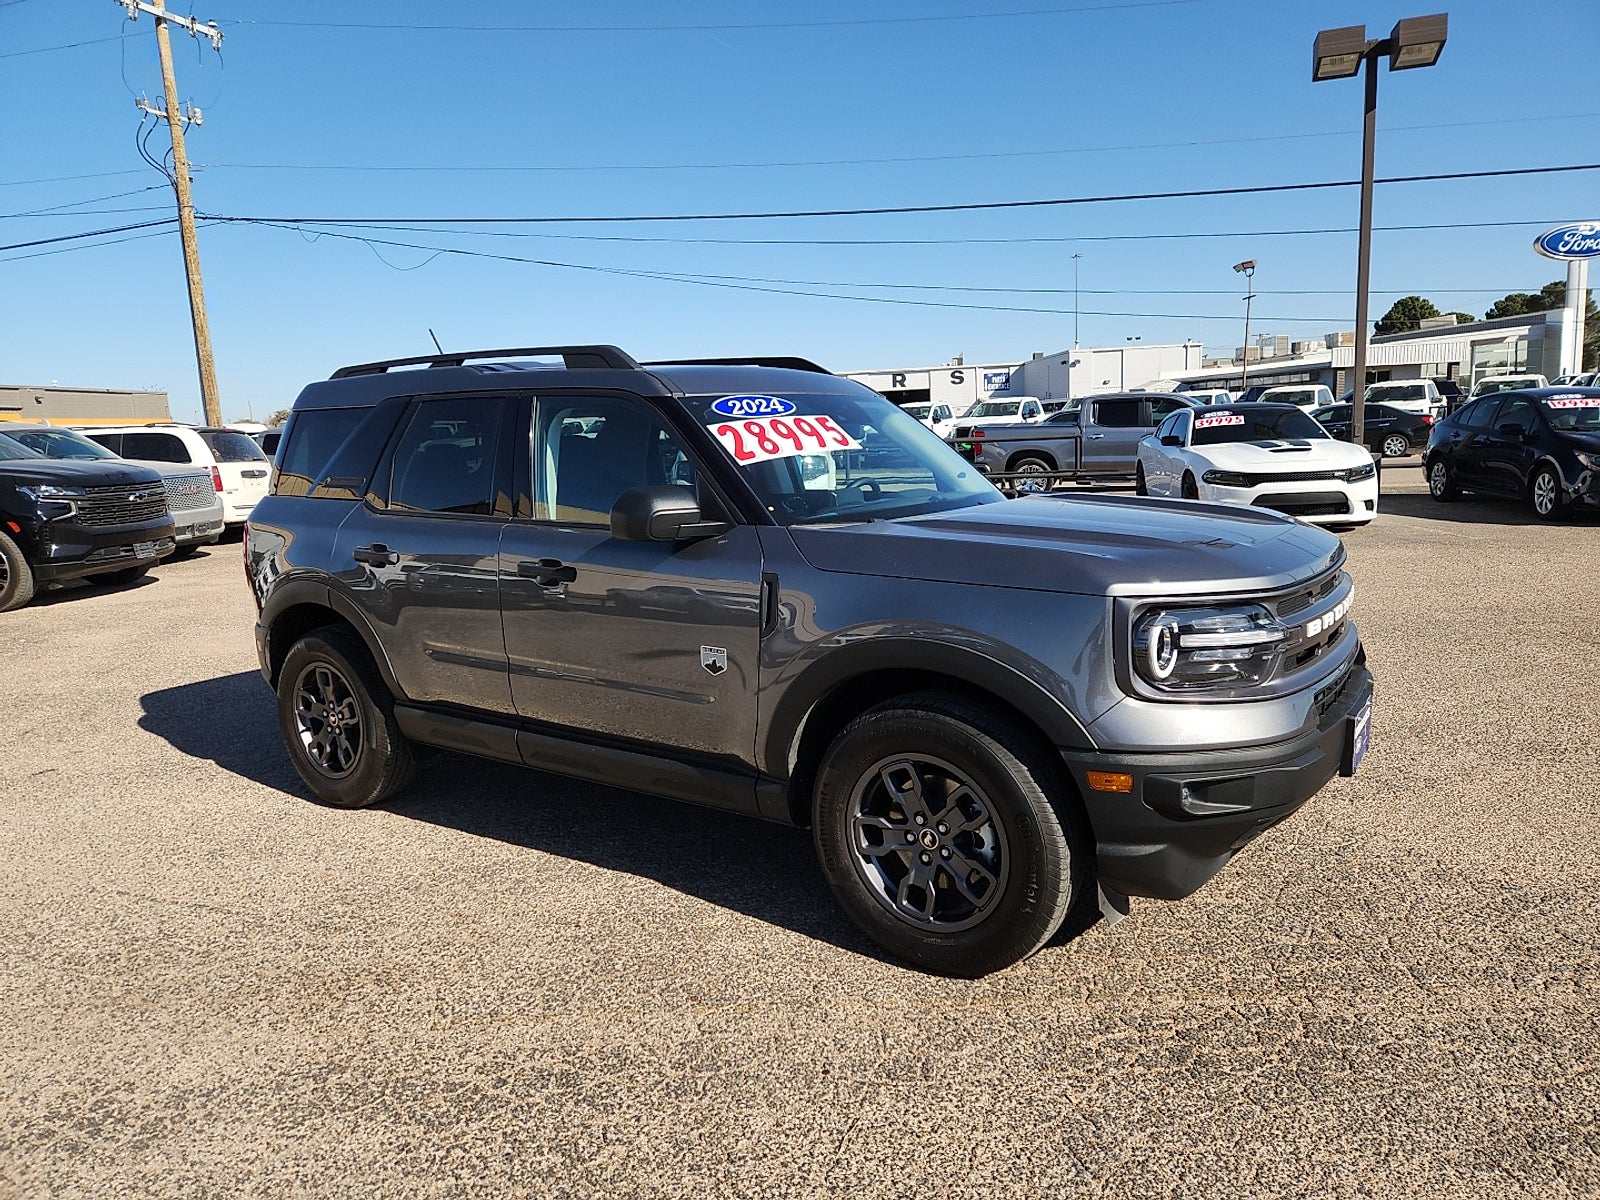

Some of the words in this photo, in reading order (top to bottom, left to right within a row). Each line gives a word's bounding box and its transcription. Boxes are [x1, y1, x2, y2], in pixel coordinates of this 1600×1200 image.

[892, 373, 907, 388] R
[950, 370, 965, 385] S
[728, 398, 785, 415] 2024
[1550, 398, 1600, 408] 19995
[1196, 416, 1242, 428] 39995
[717, 417, 850, 461] 28995
[1306, 585, 1355, 638] BRON
